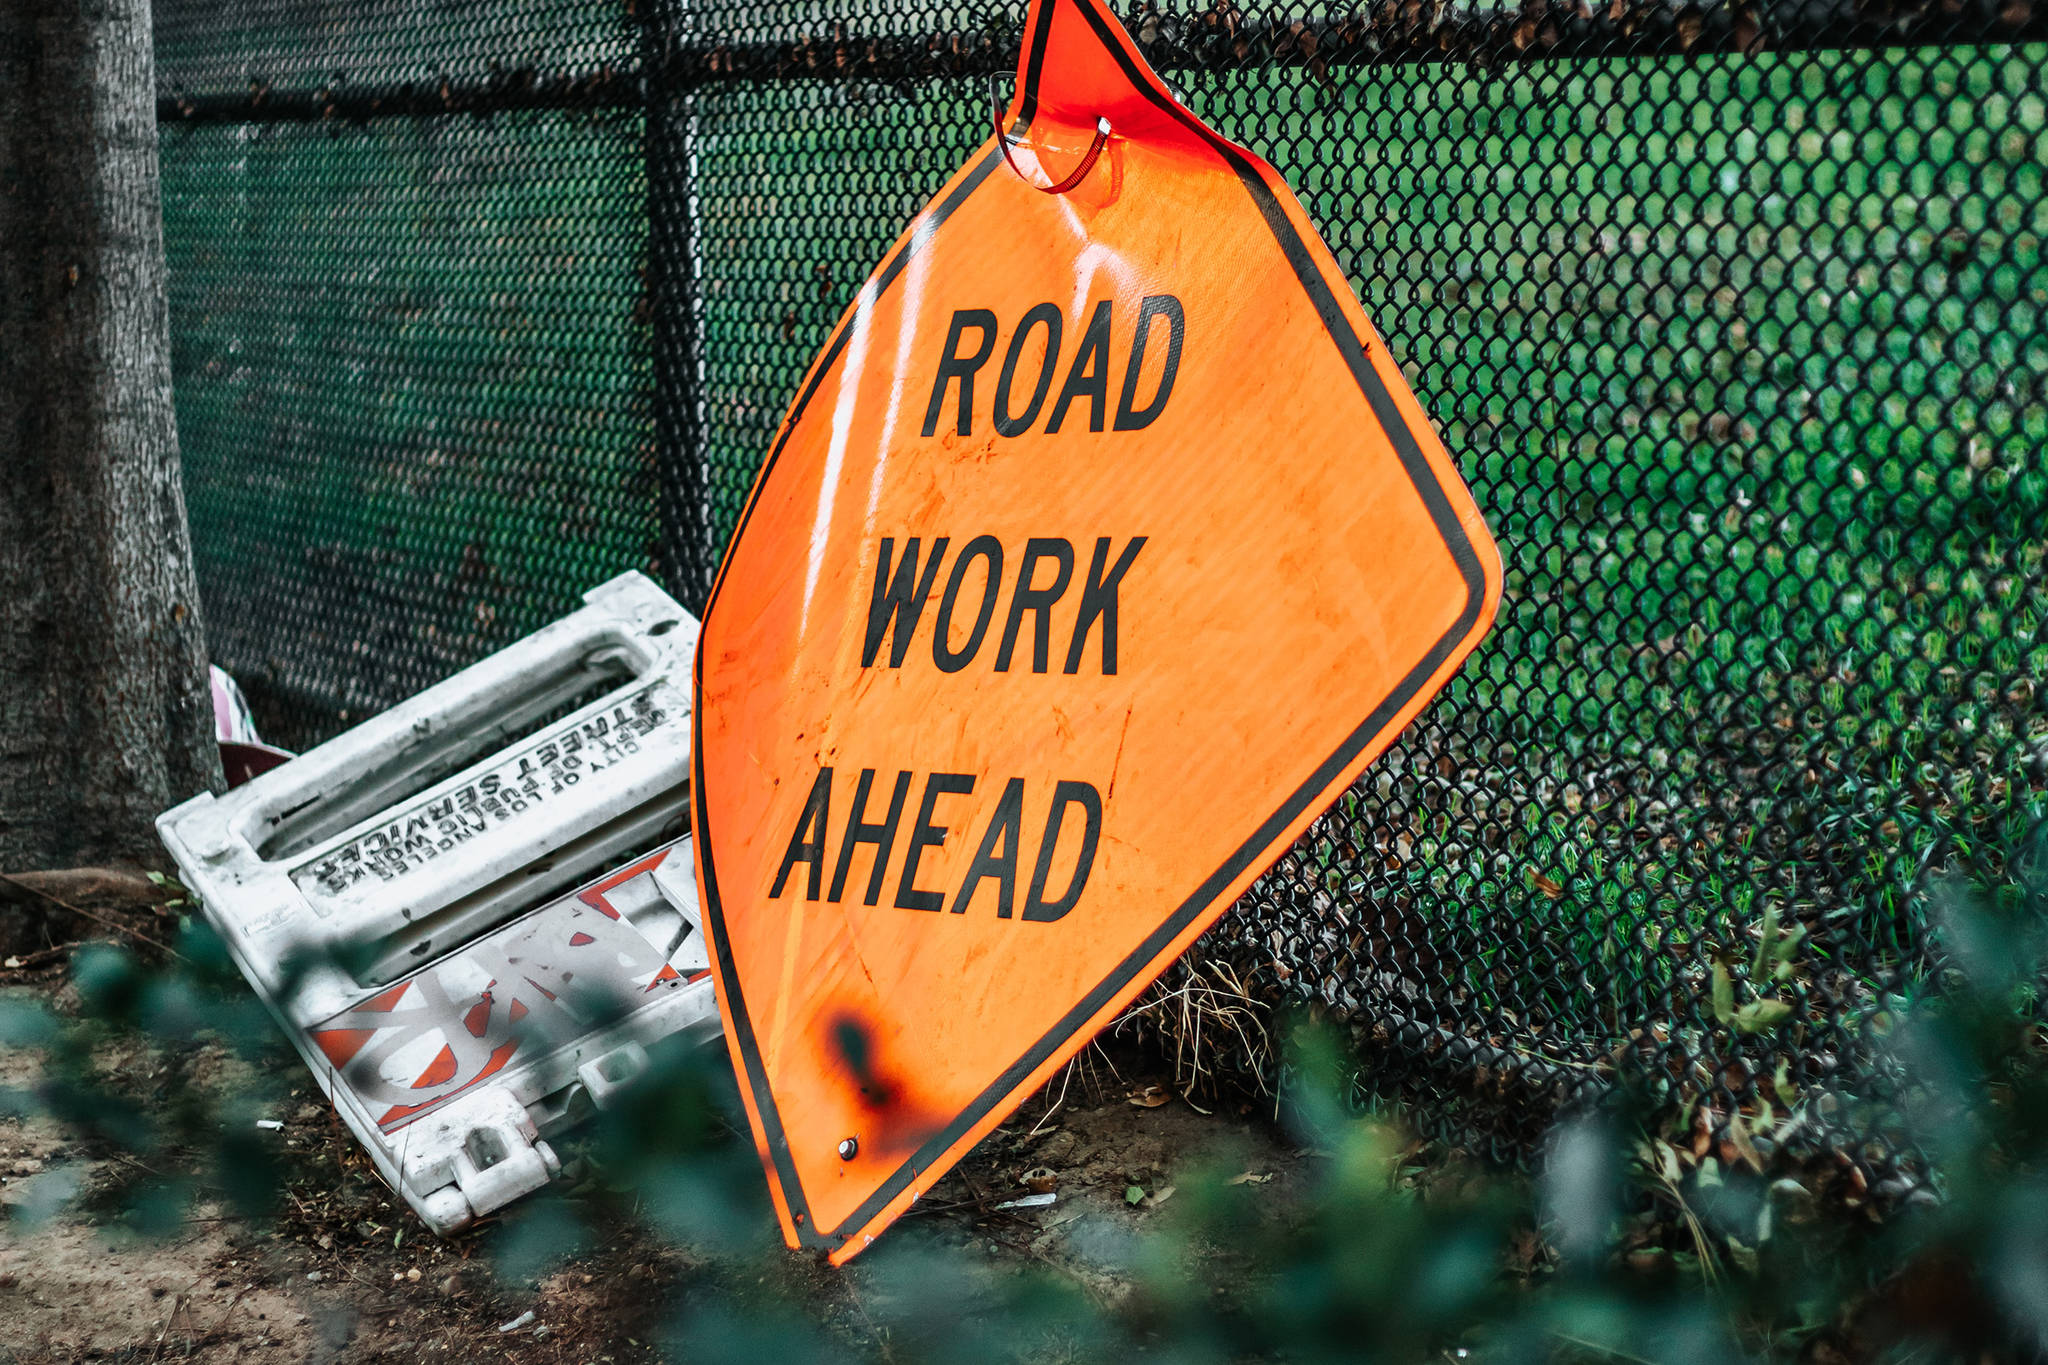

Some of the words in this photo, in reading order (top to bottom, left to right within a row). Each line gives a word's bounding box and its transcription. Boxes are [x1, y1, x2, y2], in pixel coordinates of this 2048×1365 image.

[920, 294, 1186, 438] ROAD
[860, 534, 1150, 676] WORK
[510, 691, 655, 780] STREET
[544, 752, 582, 781] OF
[588, 739, 640, 773] CITY
[435, 775, 538, 836] PUBLIC
[494, 790, 542, 821] LOS
[549, 770, 580, 795] OF
[311, 772, 503, 883] SERVICES
[378, 817, 487, 882] ANGELES
[768, 765, 1102, 922] AHEAD
